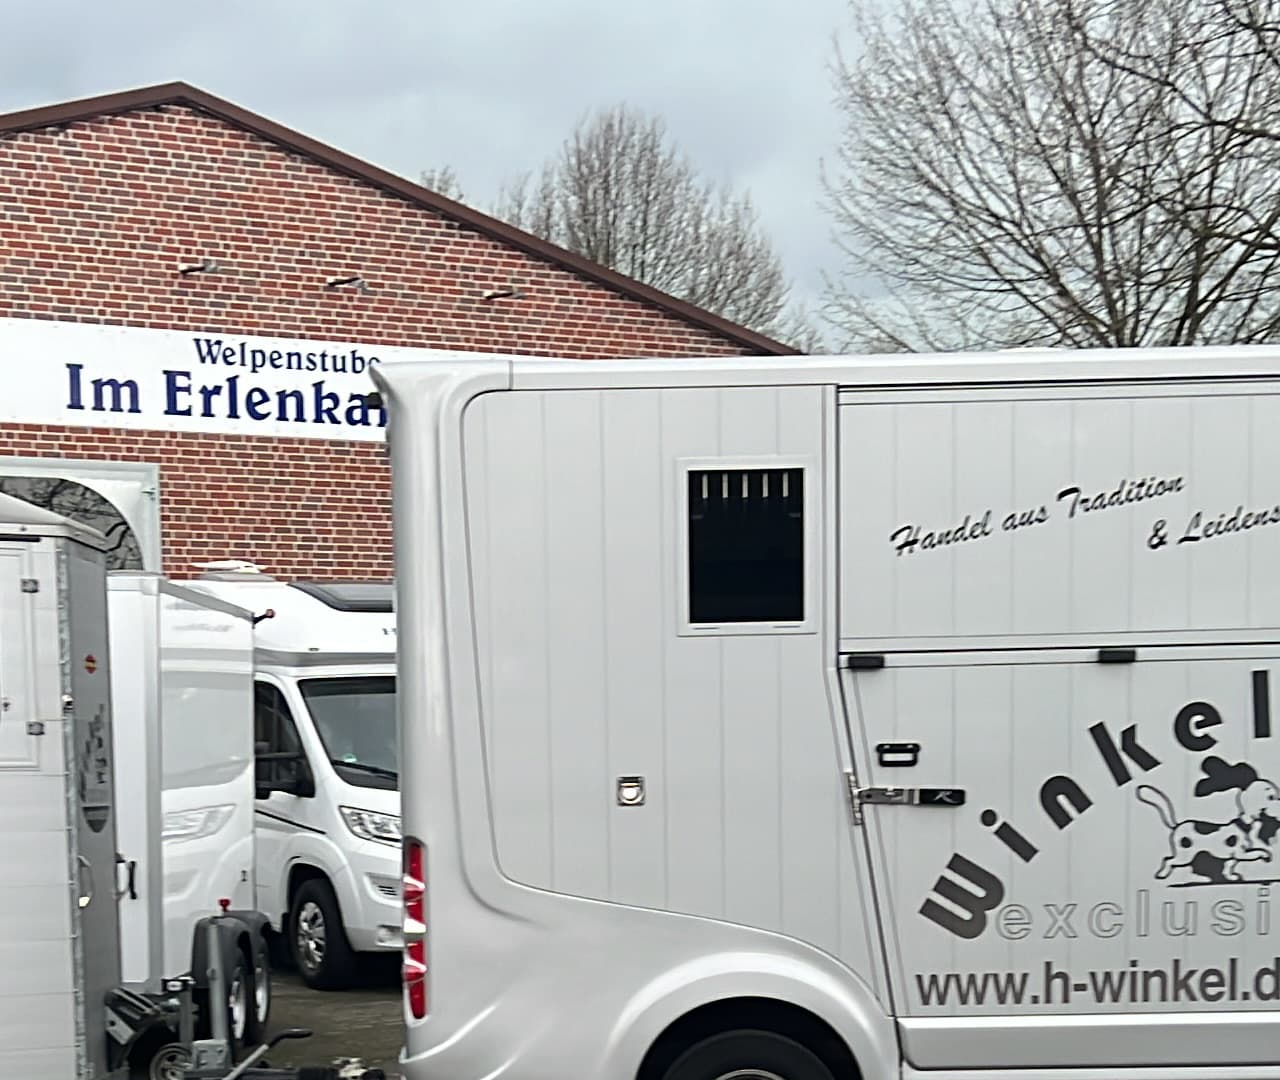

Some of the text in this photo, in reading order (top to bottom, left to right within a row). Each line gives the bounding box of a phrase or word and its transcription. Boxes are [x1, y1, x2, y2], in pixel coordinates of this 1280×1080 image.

[65, 363, 387, 427] Im Erlenka
[889, 474, 1186, 557] Handel aus Tradition
[1146, 519, 1170, 551] &
